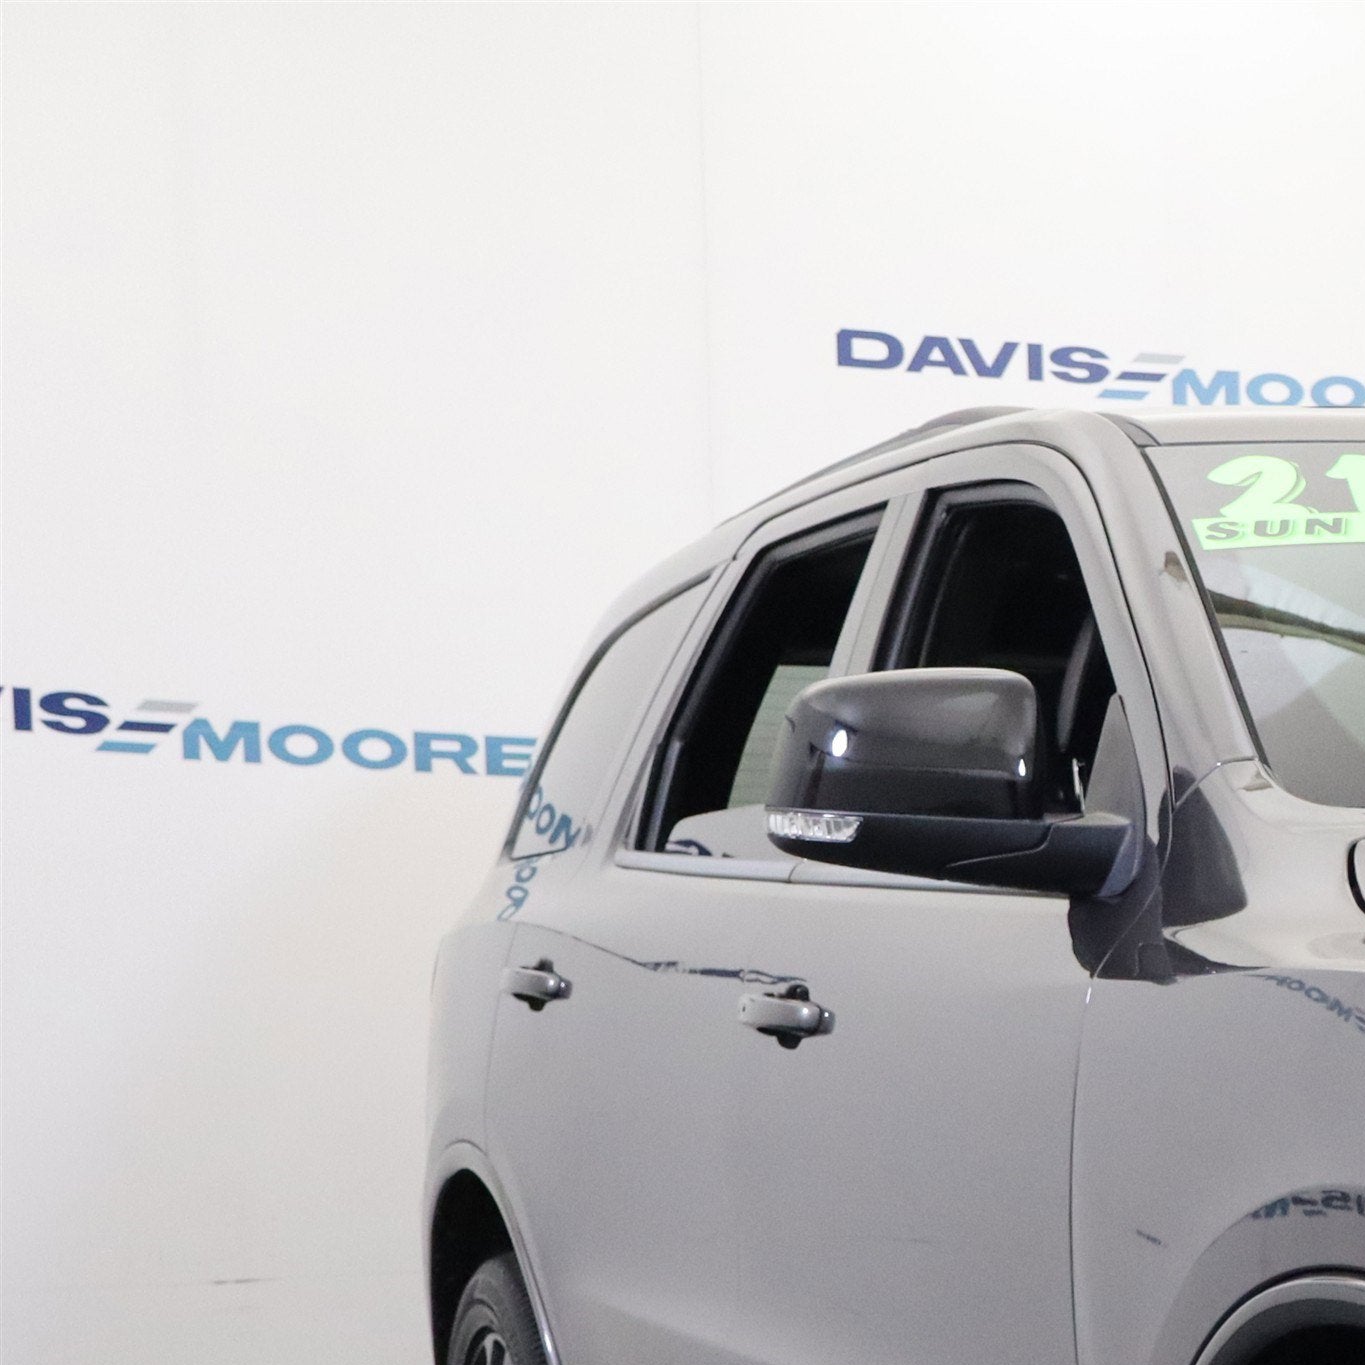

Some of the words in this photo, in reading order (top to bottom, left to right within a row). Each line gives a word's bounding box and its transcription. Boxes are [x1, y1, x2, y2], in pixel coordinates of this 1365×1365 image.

[836, 328, 1110, 384] DAVIS
[1205, 516, 1347, 541] SUN
[0, 686, 111, 735] IS
[182, 716, 538, 777] MOORE
